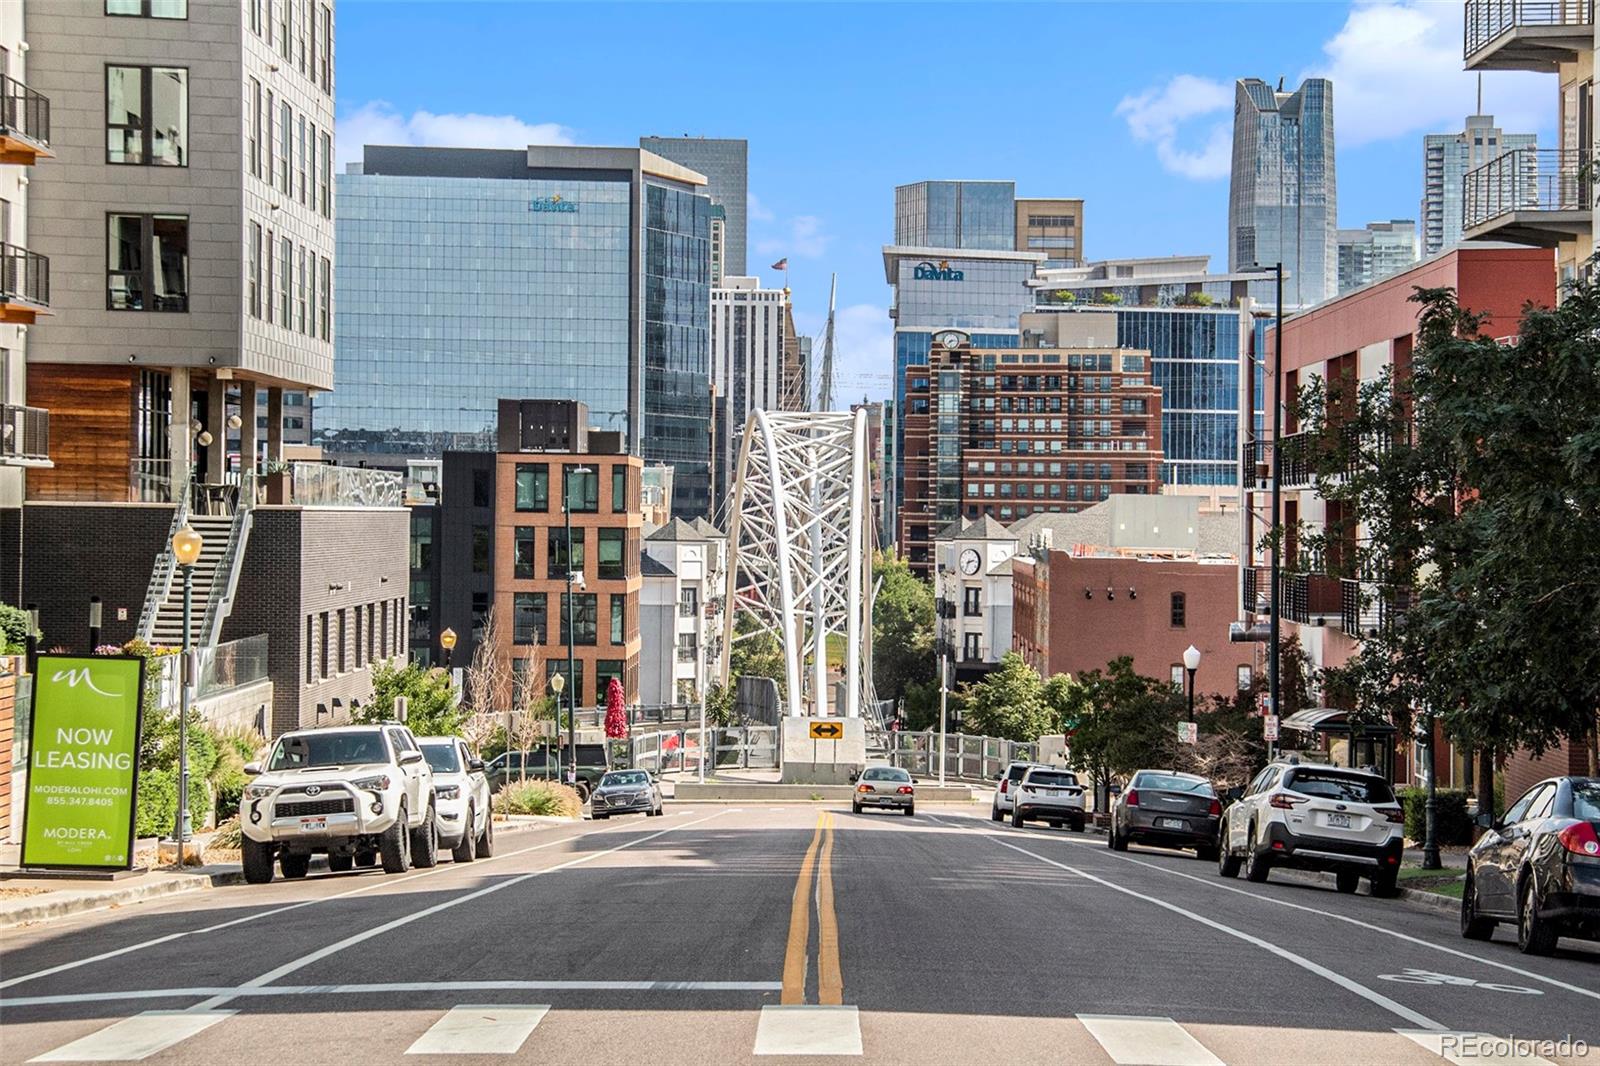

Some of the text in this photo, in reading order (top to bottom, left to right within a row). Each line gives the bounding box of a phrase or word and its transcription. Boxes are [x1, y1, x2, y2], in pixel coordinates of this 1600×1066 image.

[57, 728, 113, 746] NOW
[35, 751, 131, 770] LEASING
[34, 785, 128, 796] MODERALOHI.COM
[47, 796, 113, 807] 855.347.8405
